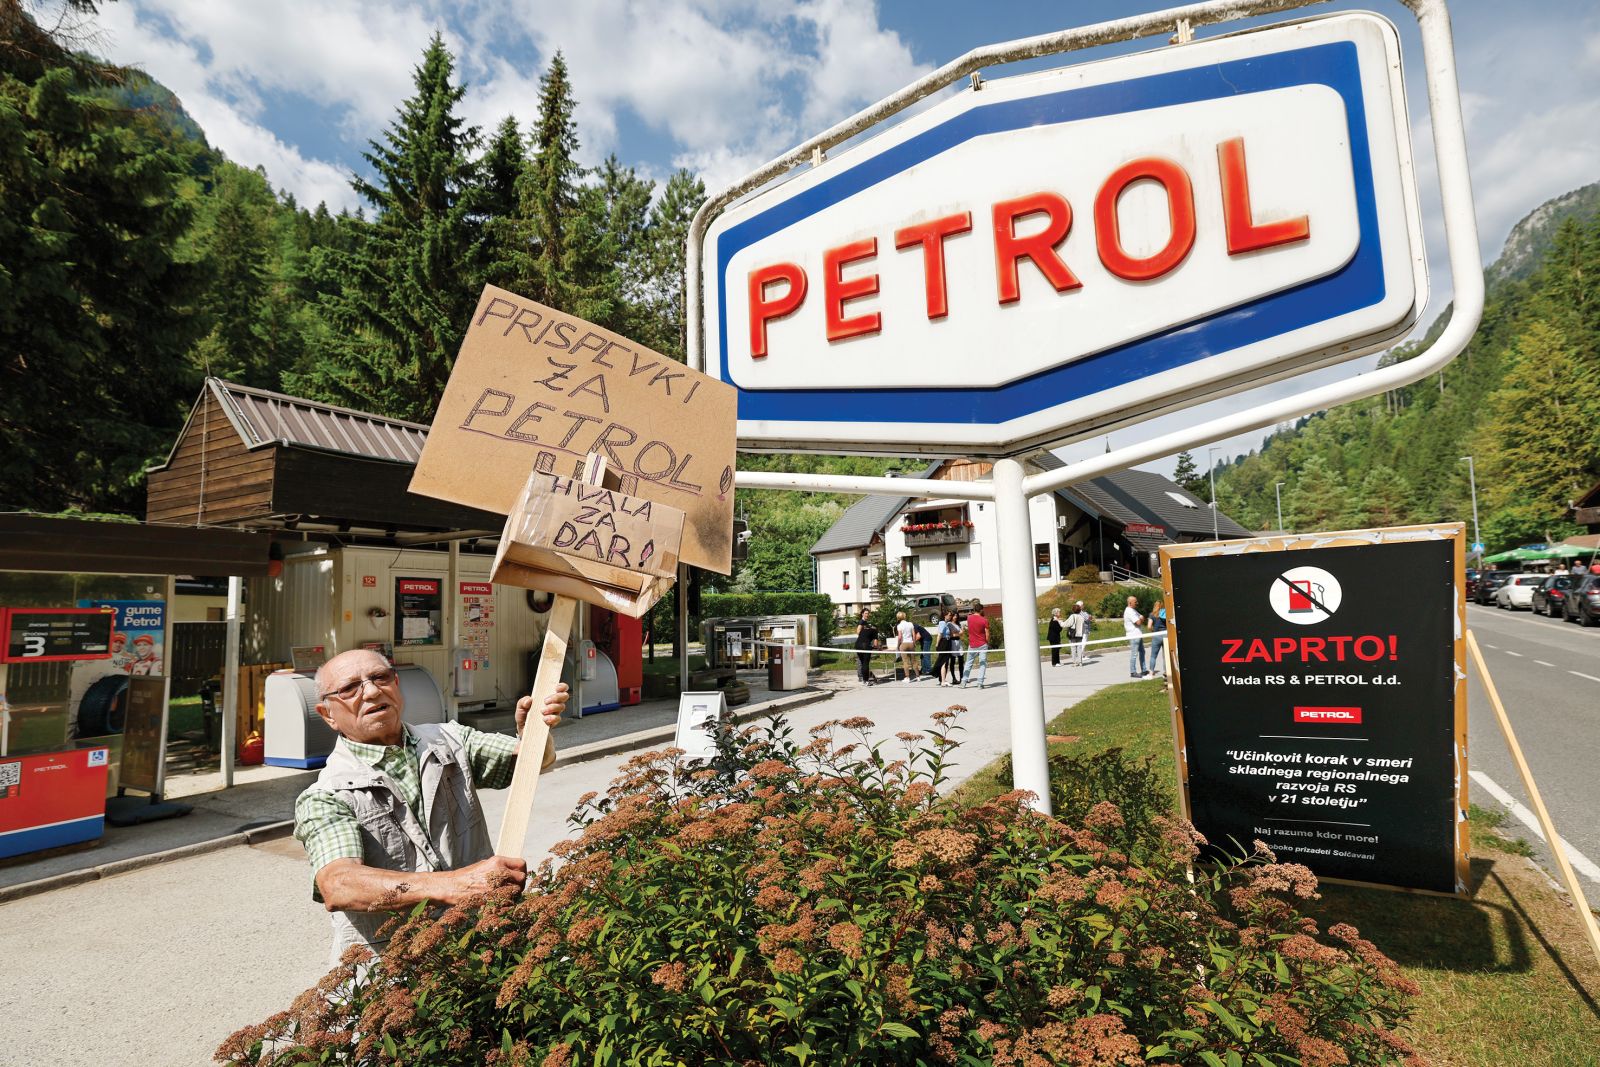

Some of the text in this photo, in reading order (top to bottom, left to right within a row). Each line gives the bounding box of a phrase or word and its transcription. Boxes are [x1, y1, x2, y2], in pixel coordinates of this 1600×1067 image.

[748, 136, 1310, 359] PETROL
[476, 297, 701, 404] PRISPEVKI
[551, 476, 652, 522] HVALA
[573, 505, 617, 533] ZA
[552, 521, 655, 568] DAR!
[126, 606, 162, 617] gume
[124, 617, 161, 627] Petrol
[22, 636, 46, 657] 3
[1221, 635, 1399, 663] ZAPRTO!
[1222, 674, 1401, 685] Vlada RS & PETROL d.d.
[1300, 710, 1354, 719] PETROL
[1305, 754, 1348, 766] korak
[1366, 757, 1413, 769] smeri
[1228, 765, 1410, 784] skladnega regionalnega
[1275, 782, 1357, 794] razvoja RS
[1268, 795, 1277, 803] v
[1280, 794, 1297, 804] 21
[1254, 826, 1379, 844] Naj razume kdor more!
[1265, 843, 1375, 861] oboko prizadeti Solčavani
